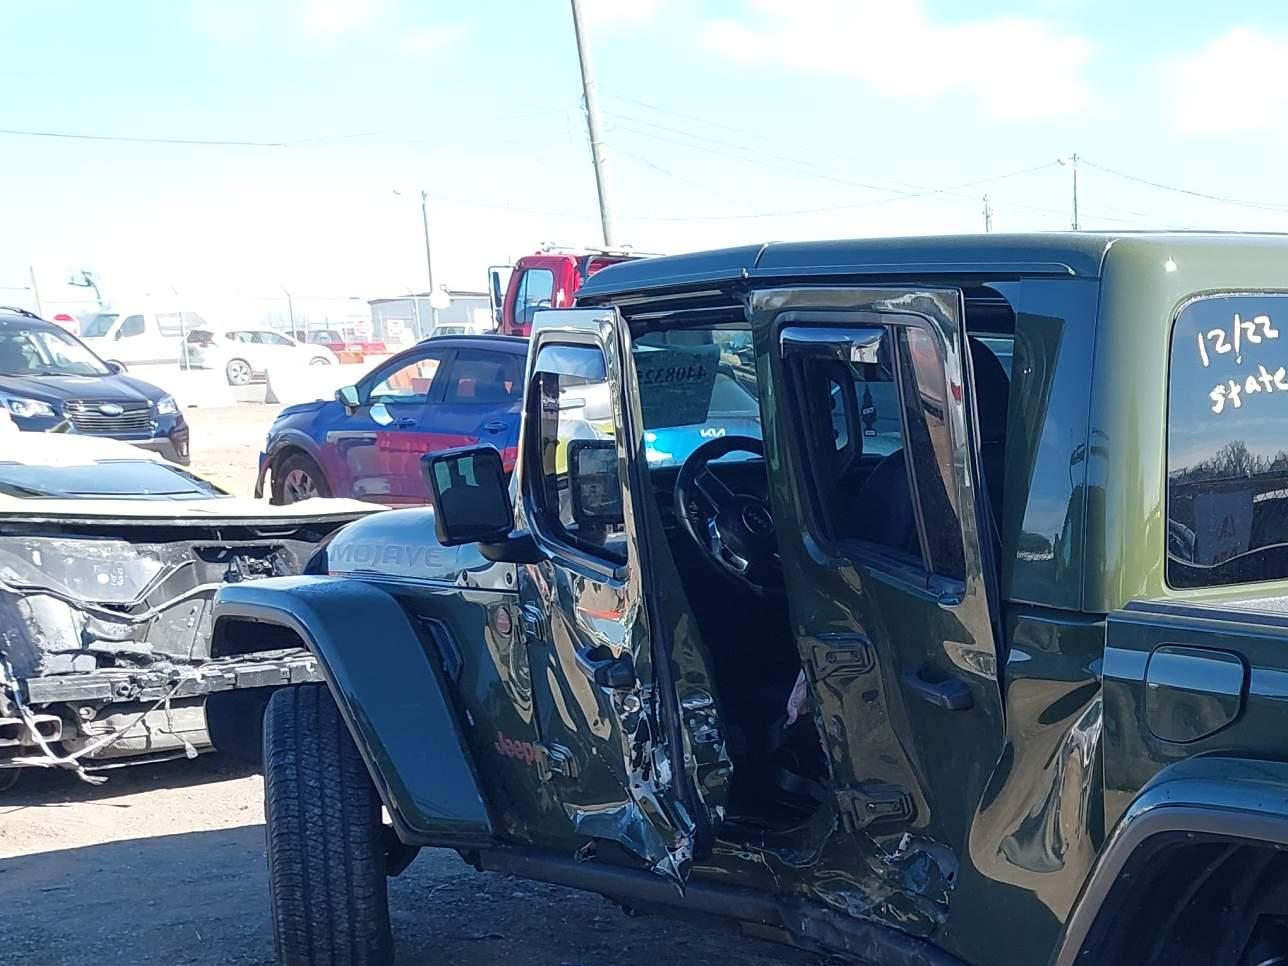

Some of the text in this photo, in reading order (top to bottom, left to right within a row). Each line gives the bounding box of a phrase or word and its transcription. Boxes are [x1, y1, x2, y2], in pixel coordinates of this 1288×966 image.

[1198, 313, 1279, 367] 12/22
[329, 542, 443, 568] MOJAVE
[494, 730, 535, 766] Jeep
